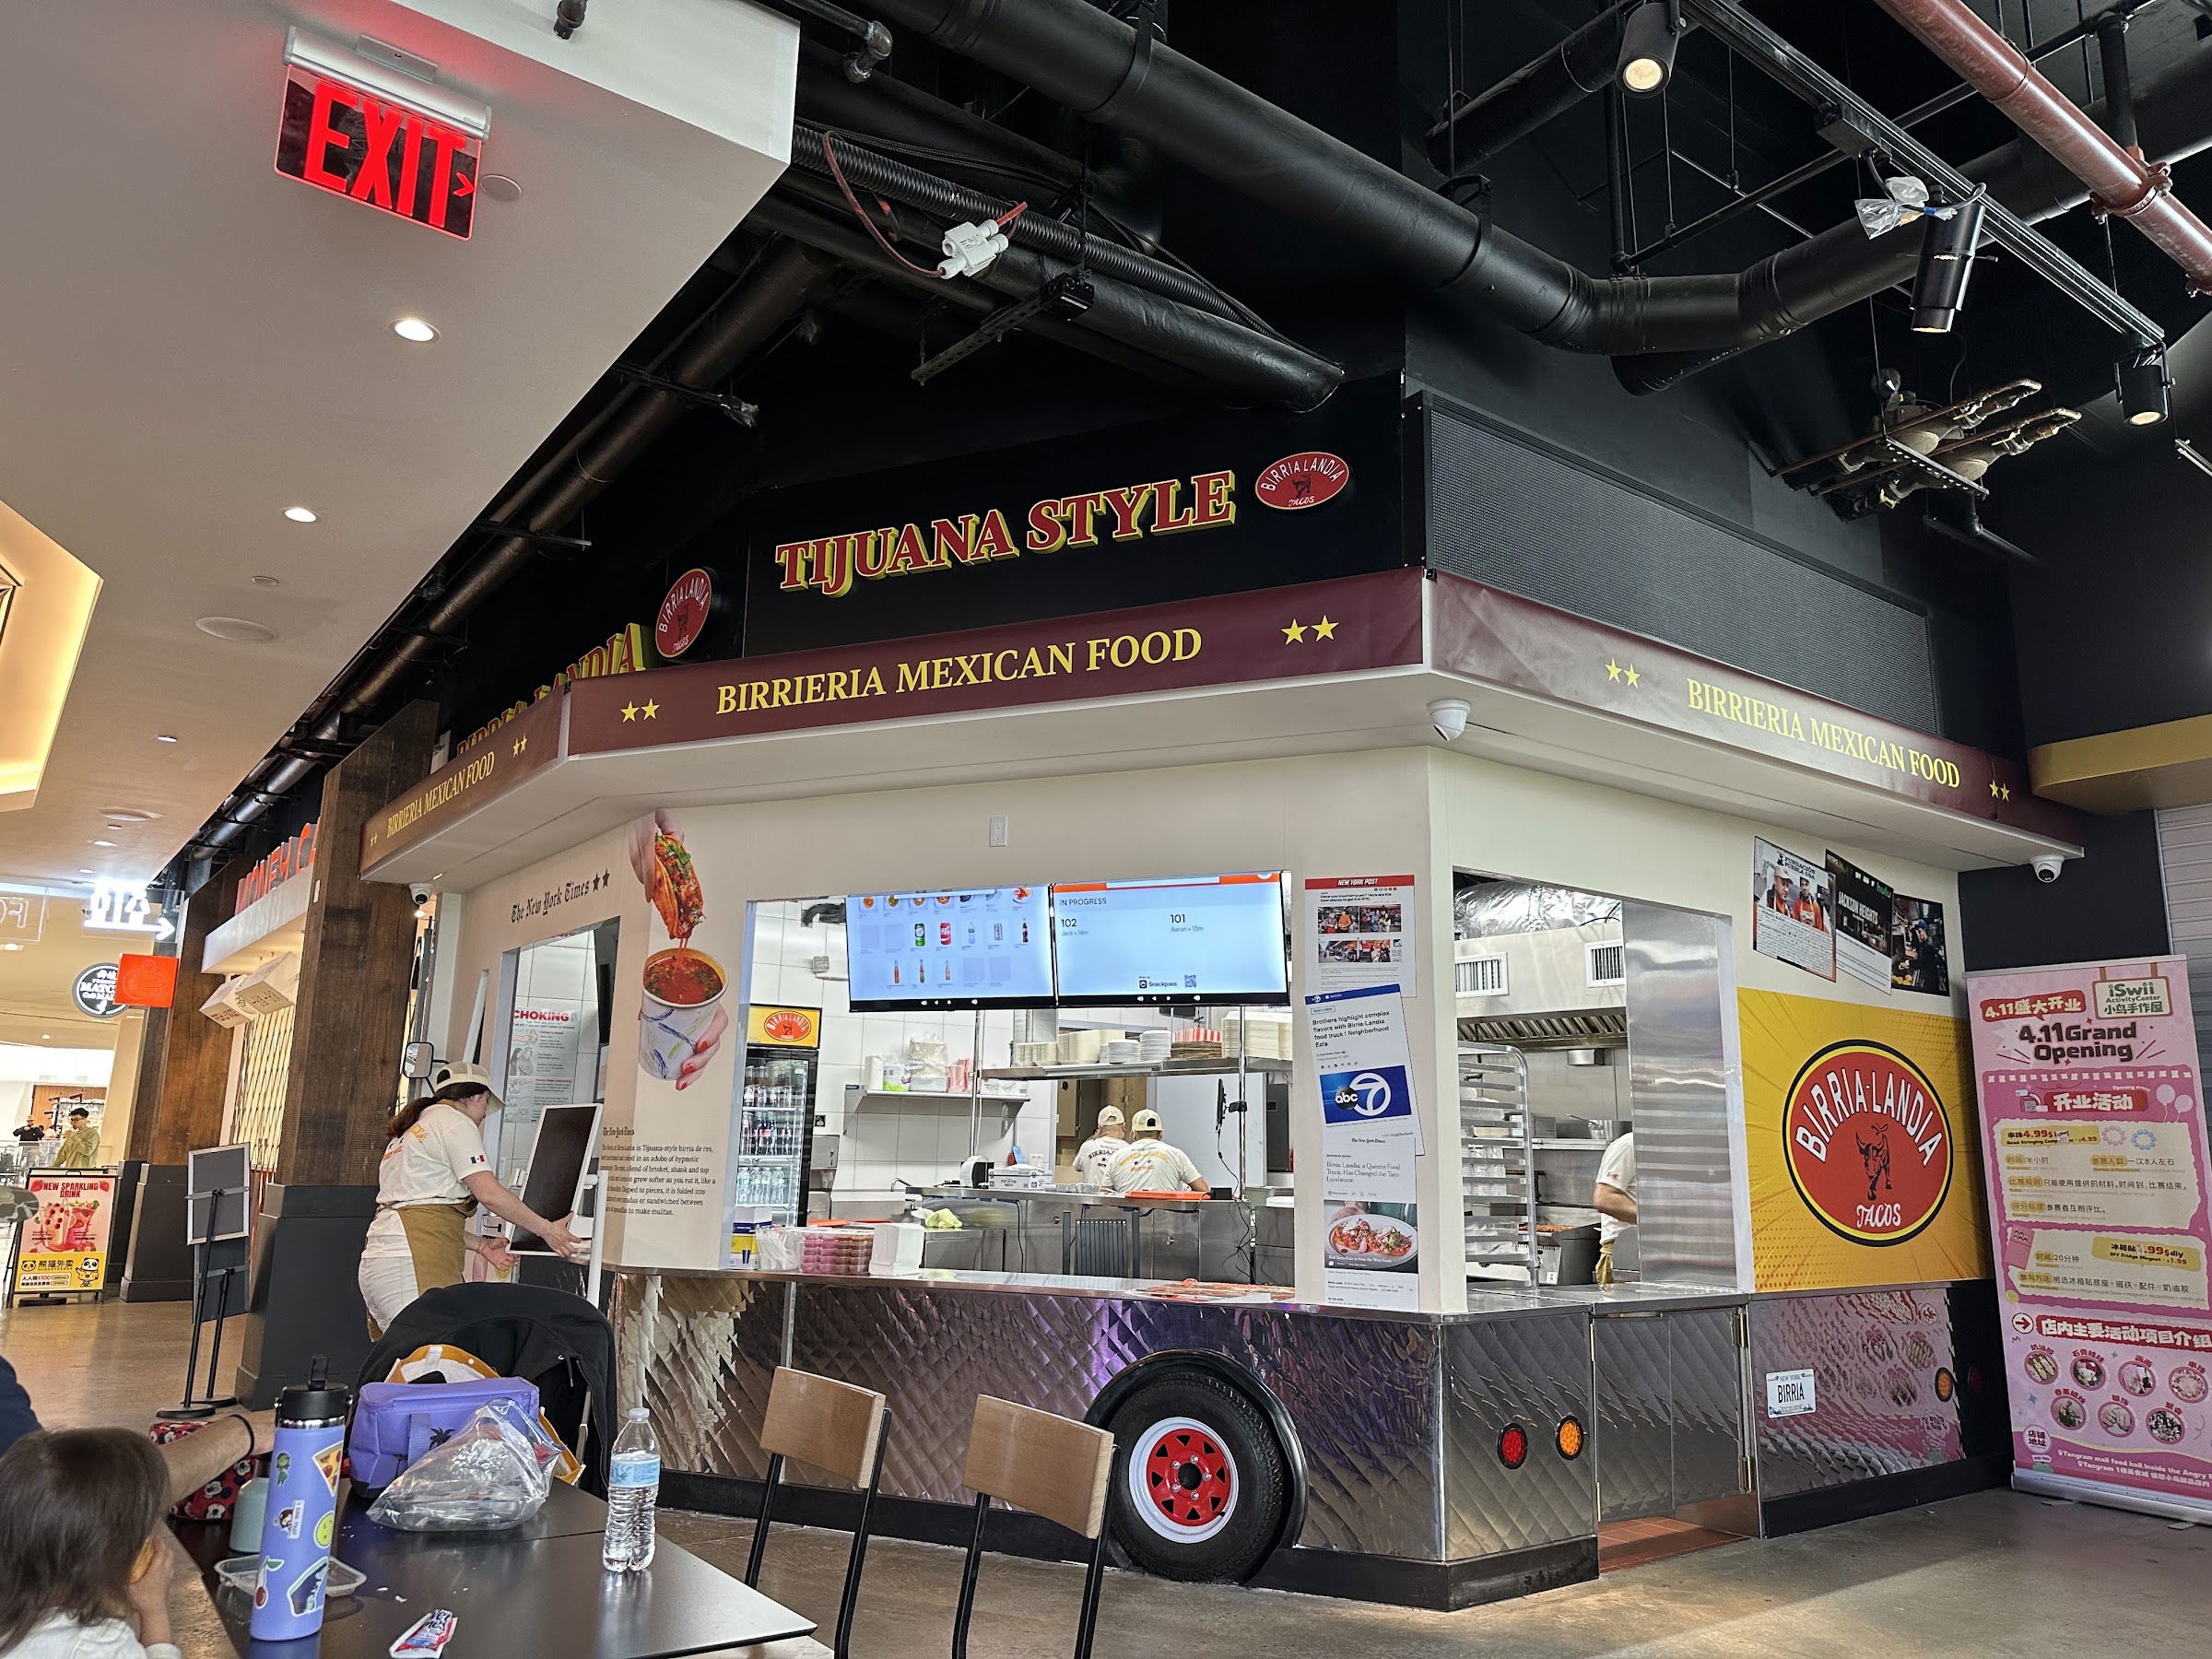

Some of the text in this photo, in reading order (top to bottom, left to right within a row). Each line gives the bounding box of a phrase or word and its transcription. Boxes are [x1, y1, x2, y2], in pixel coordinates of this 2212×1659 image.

[304, 79, 466, 229] EXIT
[1260, 457, 1345, 491] BIRRIA LANDIA
[1288, 495, 1315, 507] TACOS
[775, 469, 1235, 598] TIJUANA STYLE
[659, 577, 709, 633] BIRRIA LANDIA
[715, 627, 1202, 715] BIRRIERIA MEXICAN FOOD
[1687, 678, 1960, 788] BIRRIERIA MEXICAN FOOD
[387, 751, 495, 839] BIRRIERIA MEXICAN FOOD
[1785, 857, 1815, 874] FUNDACIÓN
[1785, 864, 1815, 880] PUEBLA USA
[1876, 882, 1891, 898] hulu
[512, 880, 590, 923] The New York Times
[1838, 891, 1859, 914] JACKSON
[1859, 903, 1879, 925] HEIGHTS
[1061, 919, 1077, 927] 102
[1170, 914, 1185, 923] 101
[2109, 982, 2154, 997] iSwii
[513, 1010, 569, 1022] CHOKING
[1985, 996, 2082, 1018] 4.11盛大开业
[1348, 1026, 1389, 1036] Neighborhood
[2034, 1042, 2132, 1064] Opening
[1335, 1092, 1358, 1103] abc
[2053, 1092, 2133, 1112] 开业活动
[1795, 1067, 1943, 1166] BIRRIA-LANDIA
[1856, 1203, 1901, 1228] TACOS
[2041, 1319, 2212, 1348] 店内主要活动项目介绍
[1778, 1382, 1805, 1403] BIRRIA
[2063, 1450, 2093, 1460] Tangram
[2111, 1458, 2127, 1466] food
[2183, 1470, 2206, 1480] Angry
[2083, 1462, 2114, 1472] Tangram
